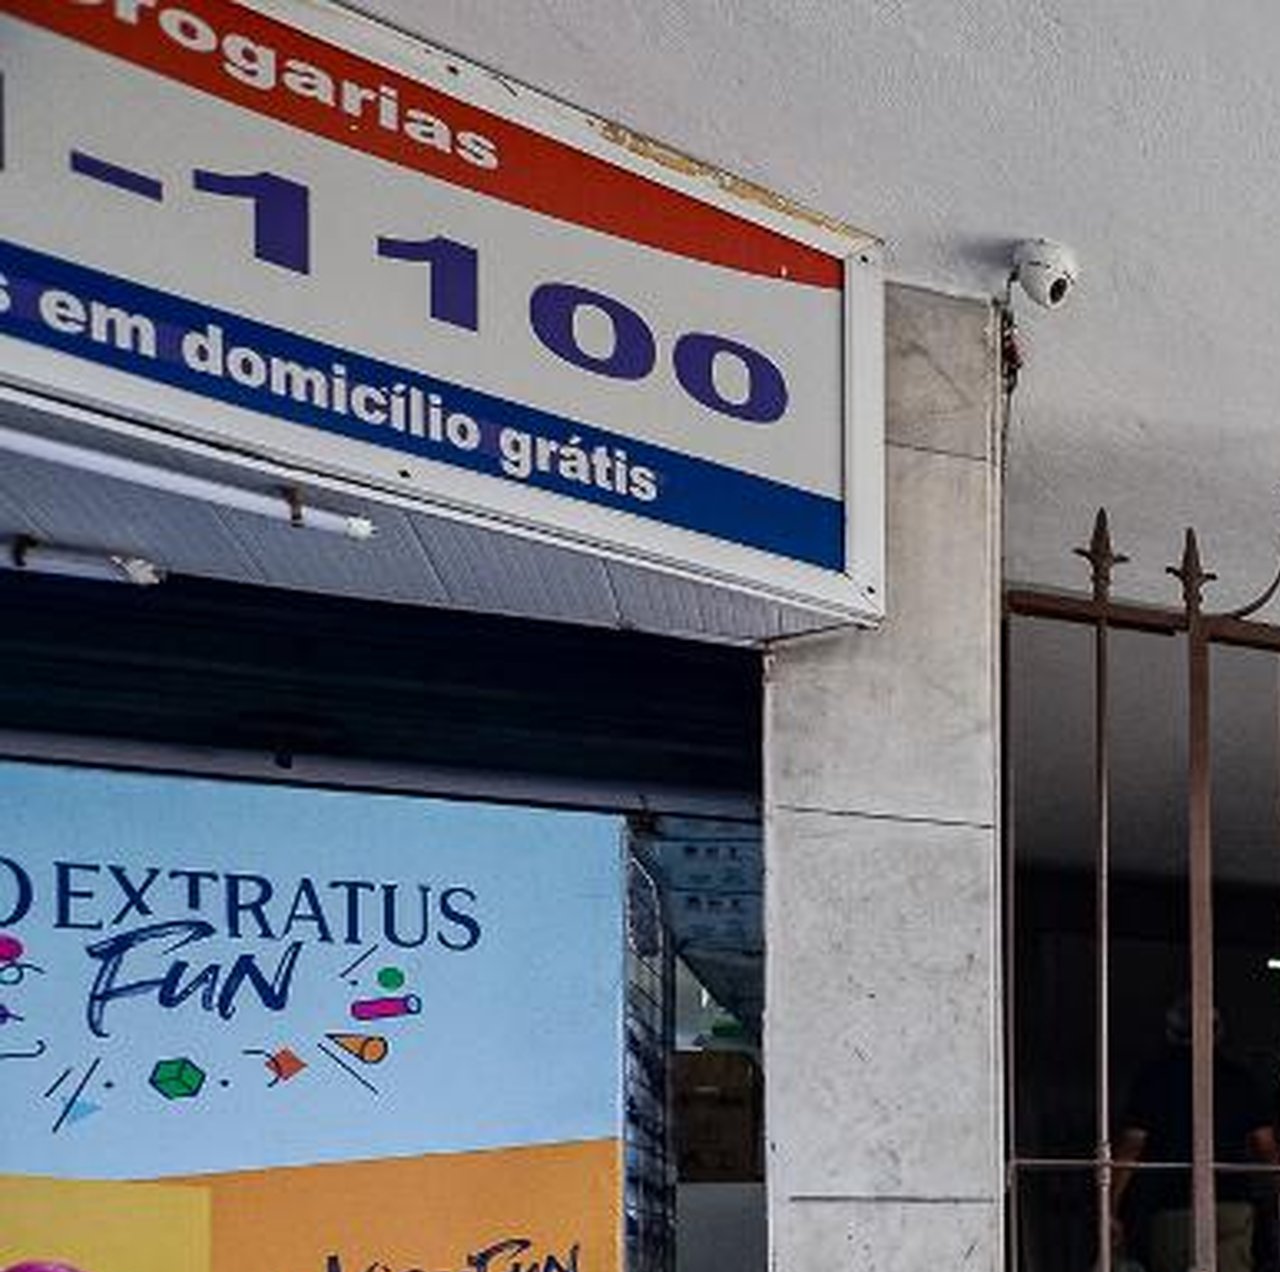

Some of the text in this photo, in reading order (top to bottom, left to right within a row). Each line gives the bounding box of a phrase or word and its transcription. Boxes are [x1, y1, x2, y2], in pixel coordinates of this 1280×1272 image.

[68, 0, 499, 170] rogarias
[0, 70, 790, 425] -1100
[39, 289, 157, 359] em
[181, 324, 482, 451] domicílio
[498, 426, 659, 502] grátis
[53, 861, 482, 951] EXTRATUS
